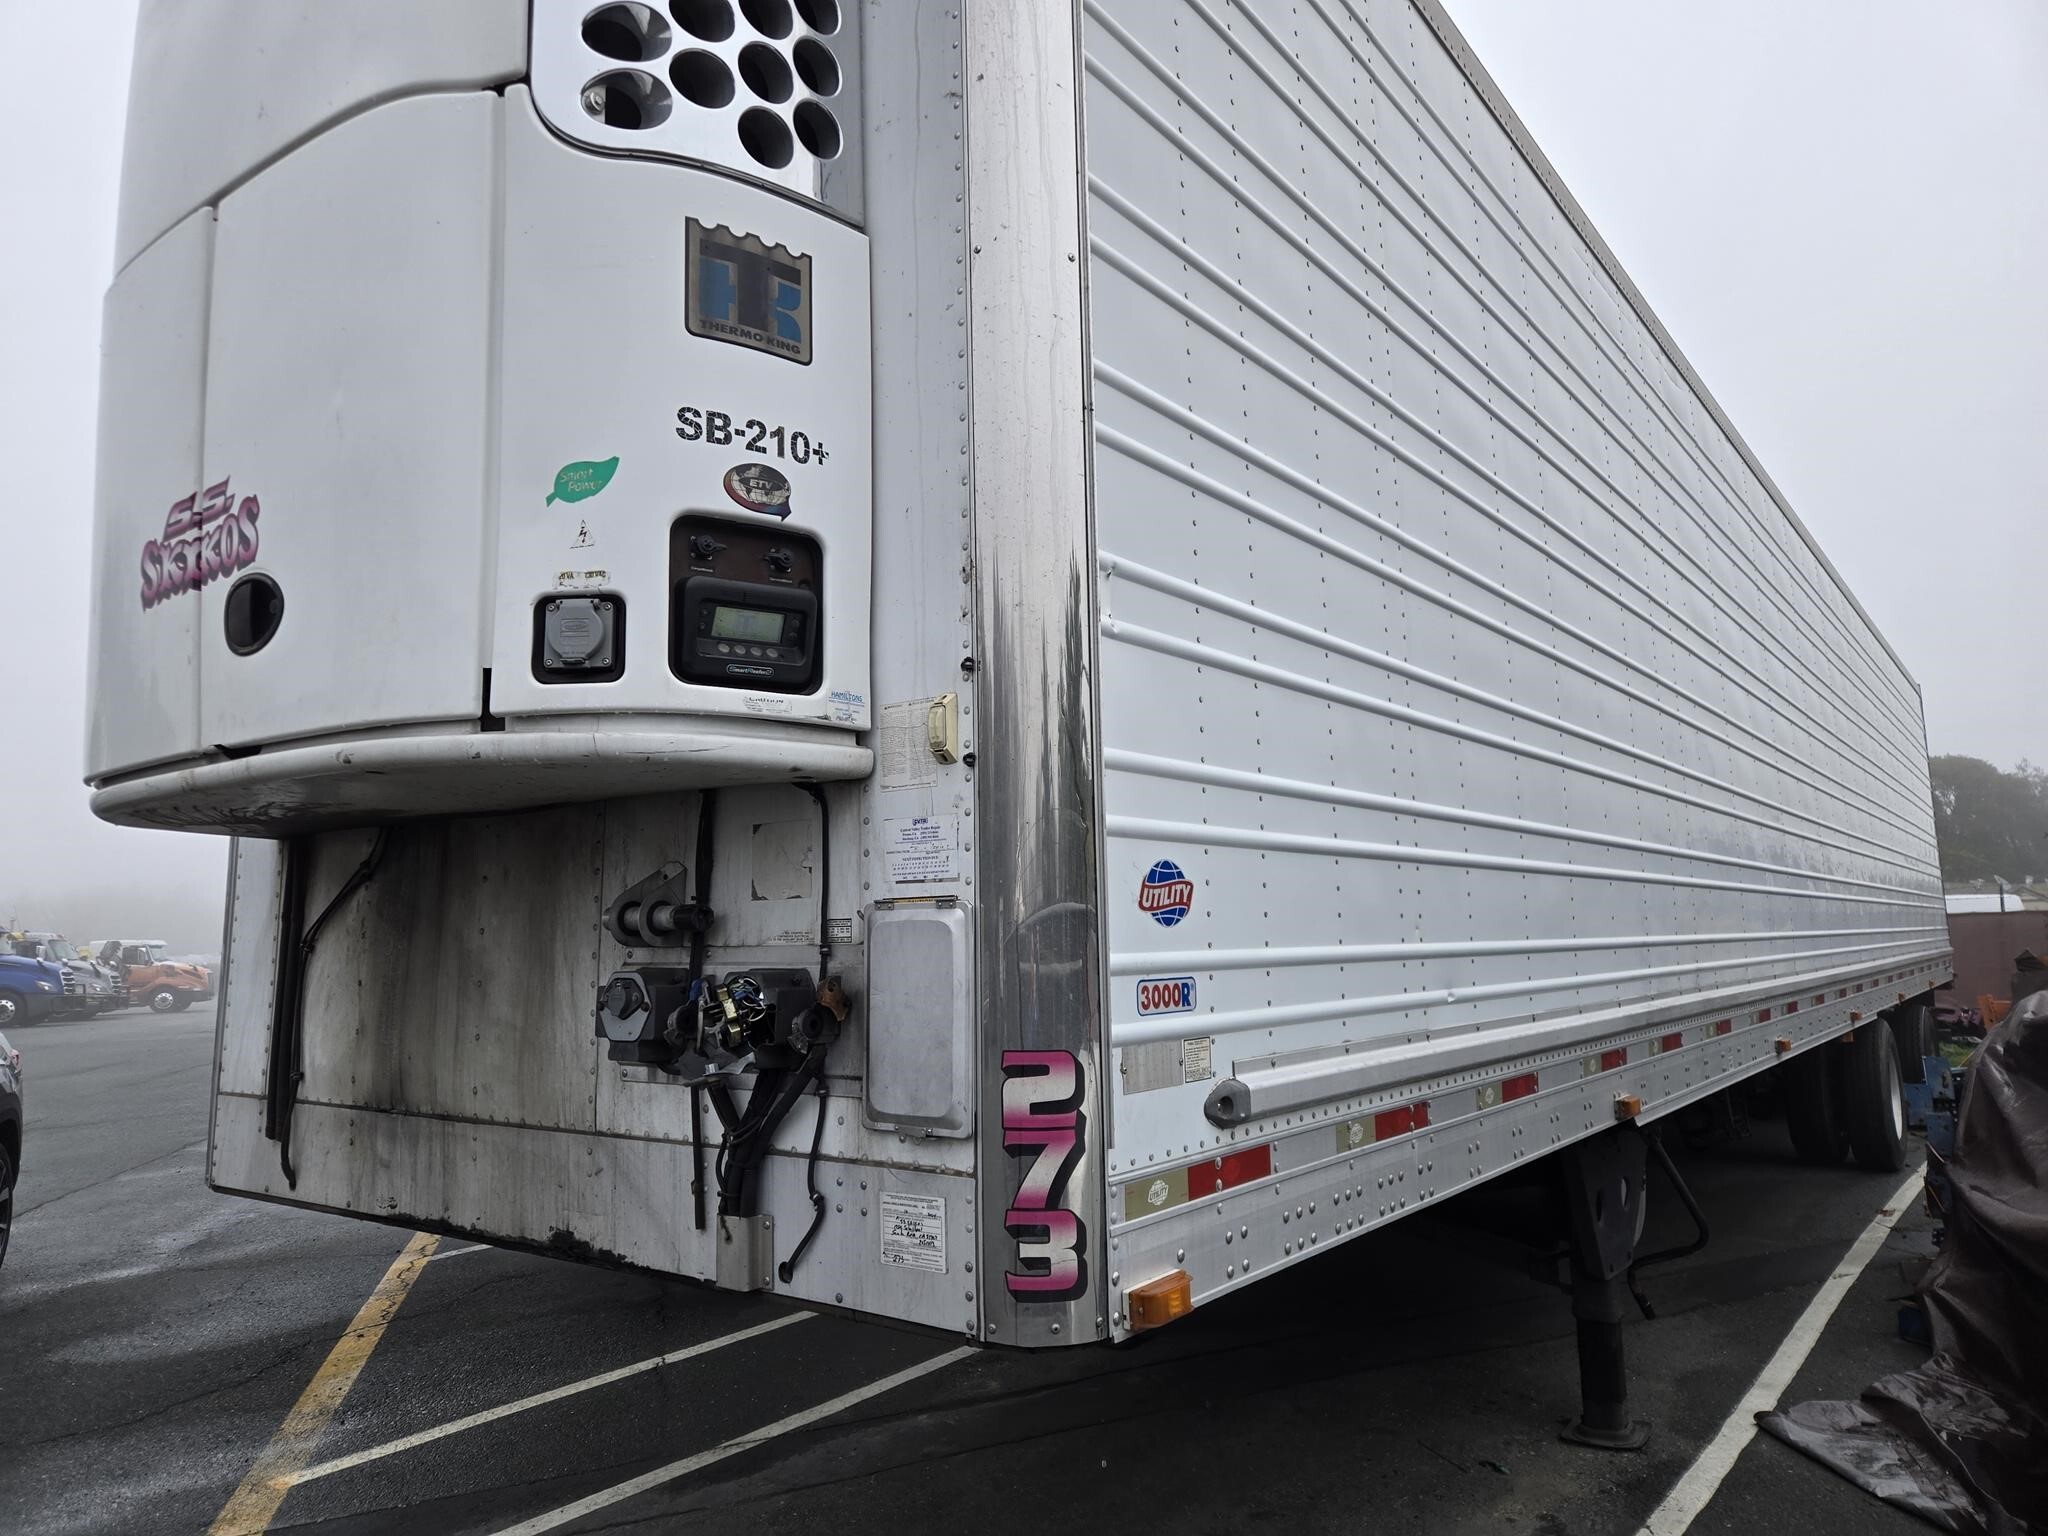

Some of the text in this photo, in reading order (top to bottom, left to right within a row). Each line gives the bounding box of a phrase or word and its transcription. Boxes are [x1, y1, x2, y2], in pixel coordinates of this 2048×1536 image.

[699, 319, 802, 355] THERMO KING
[675, 406, 830, 466] SB-210+
[750, 478, 775, 490] ETV
[831, 690, 864, 703] HAMILTONS
[1142, 883, 1191, 908] UTILITY
[1001, 1050, 1088, 1302] 273
